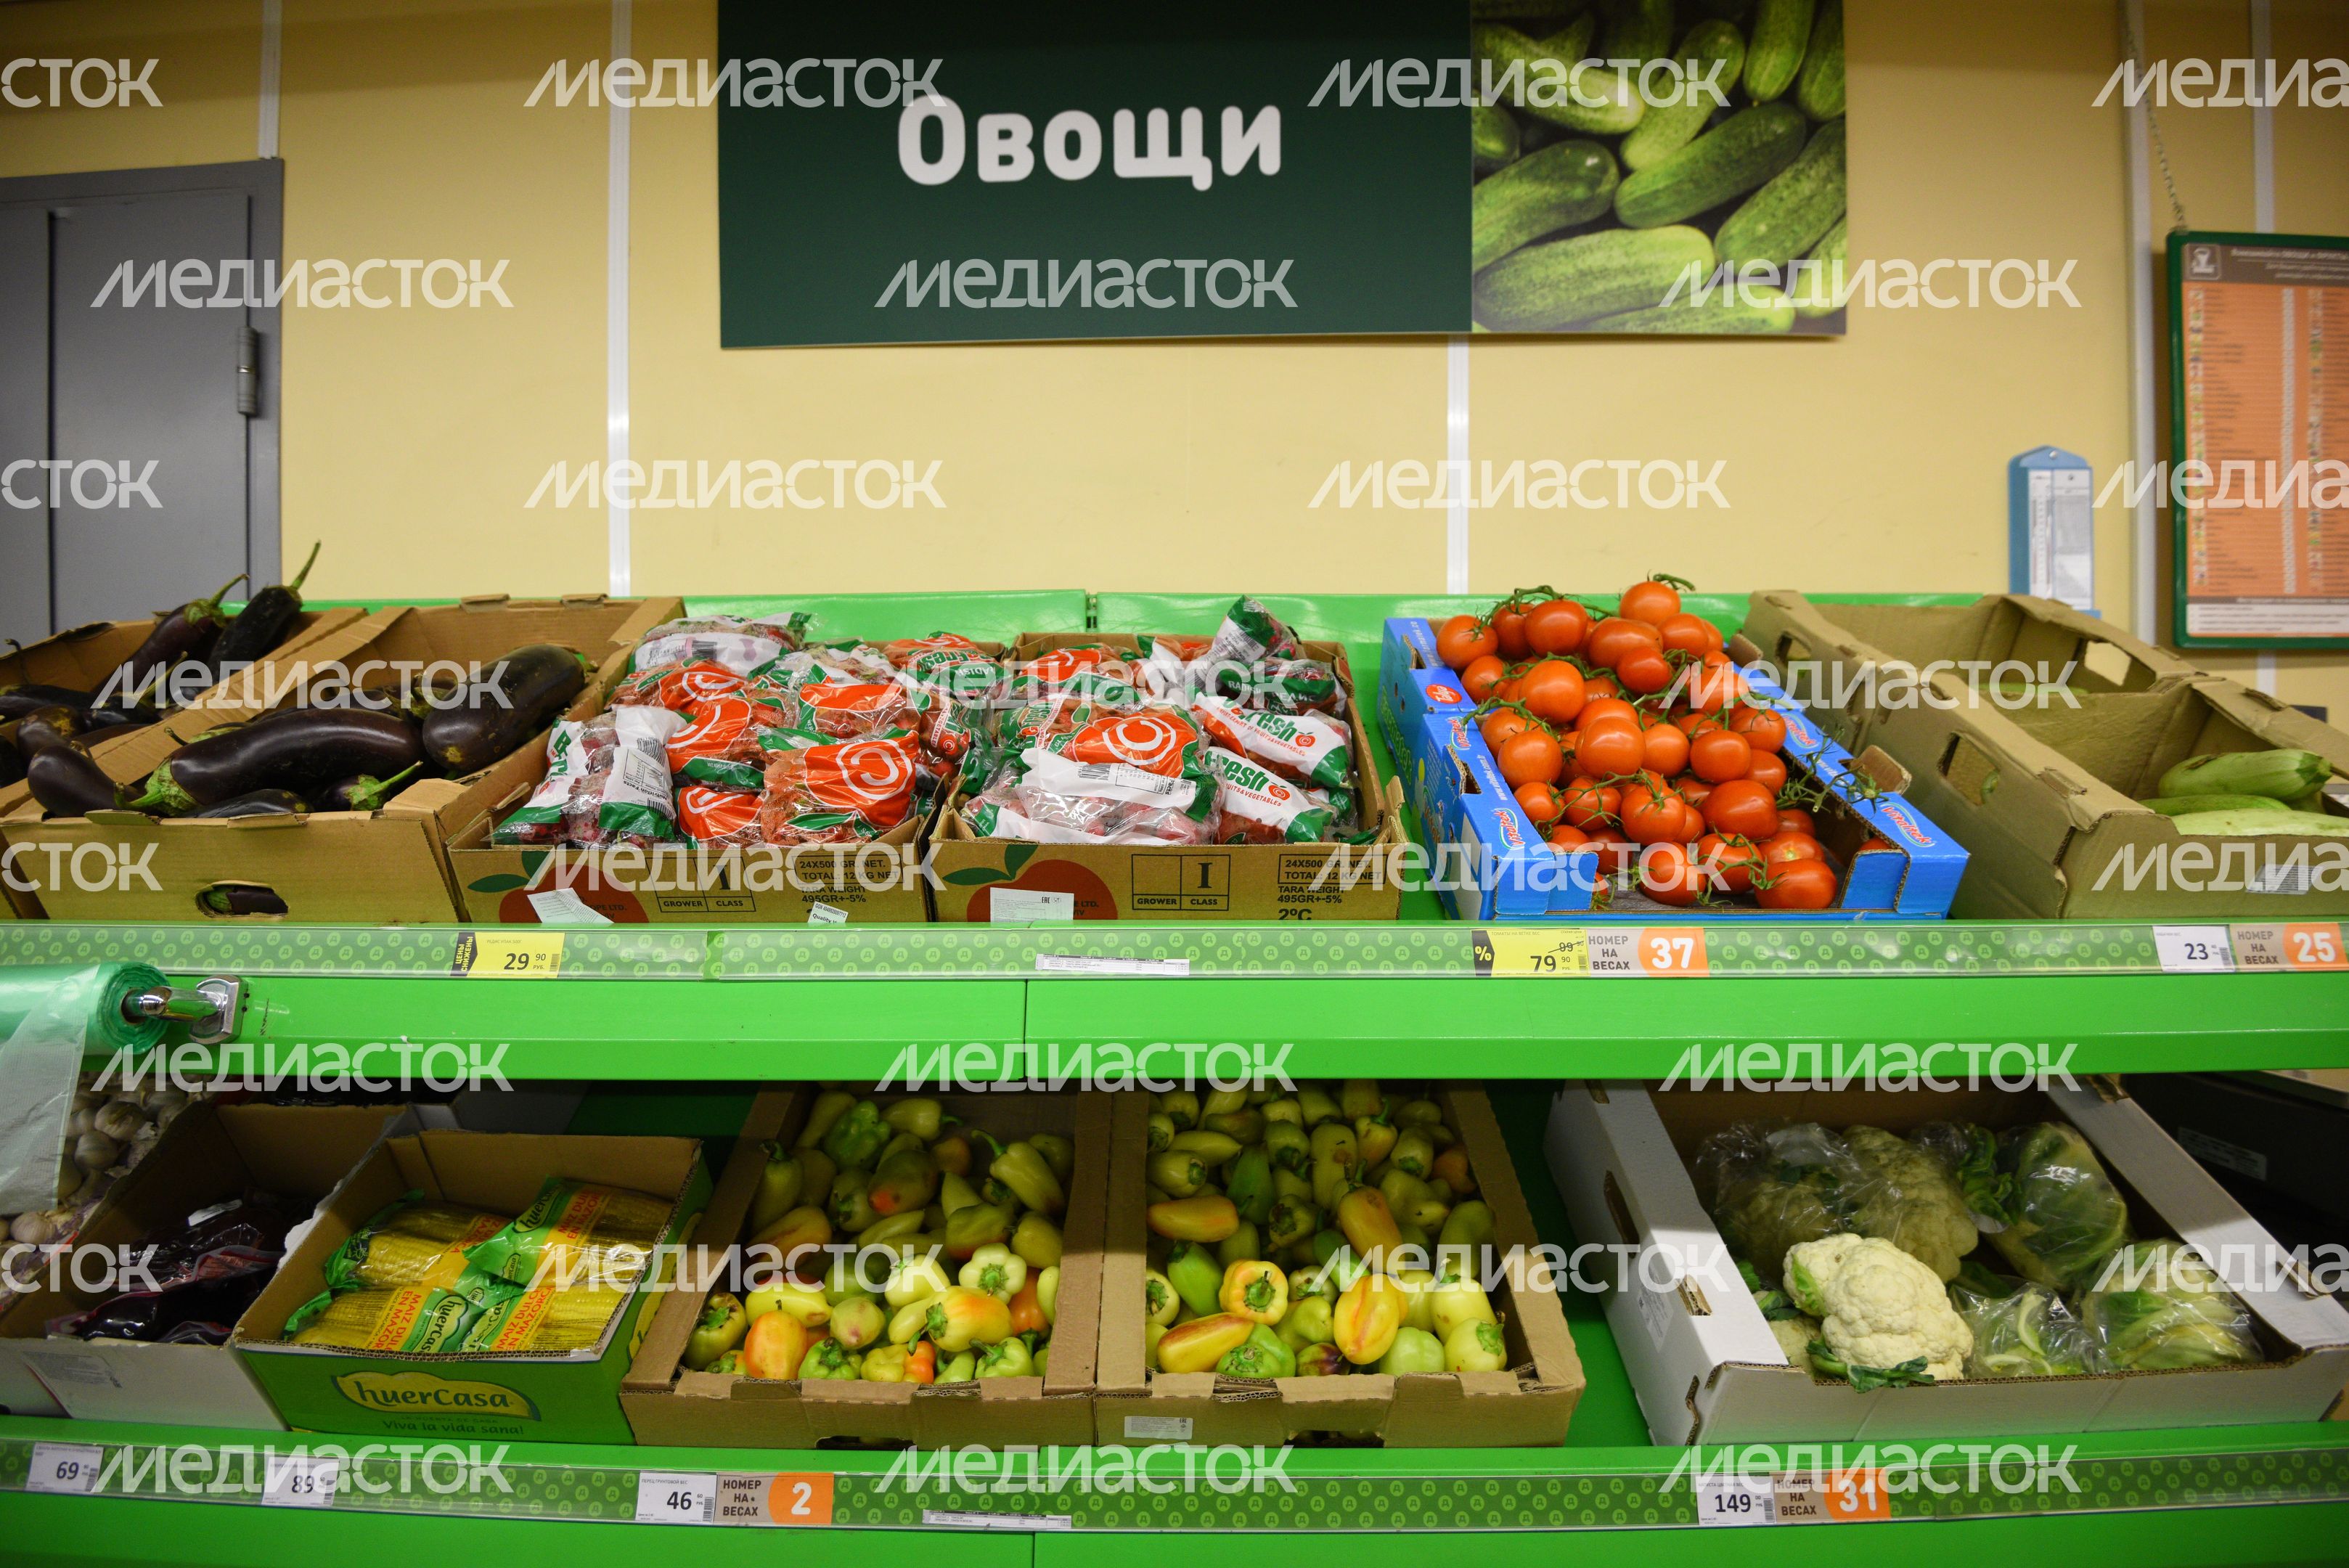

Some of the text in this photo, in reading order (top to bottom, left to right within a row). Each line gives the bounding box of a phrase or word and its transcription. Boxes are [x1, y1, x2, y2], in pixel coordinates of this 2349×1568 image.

[899, 95, 1281, 191] Овощи
[799, 860, 836, 869] 24X500
[1286, 859, 1323, 868] 24X500
[1285, 871, 1323, 880] TOTAL:
[1327, 871, 1338, 880] 12
[802, 894, 867, 903] 495GR+-5%
[1278, 895, 1342, 904] 495GR+-5%
[1588, 936, 1628, 944] НОМЕР
[2237, 931, 2274, 940] НОМЕР
[455, 944, 465, 964] ЦЕНЫ
[461, 936, 474, 972] СНИЖЕНЫ
[1559, 942, 1573, 952] 99
[1602, 949, 1618, 957] НА
[1651, 937, 1694, 968] 37
[2185, 943, 2209, 960] 23
[2293, 932, 2335, 963] 25
[504, 953, 529, 970] 29
[1530, 955, 1556, 973] 79
[1593, 961, 1630, 970] ВЕСАХ
[2244, 955, 2279, 965] ВЕСАХ
[399, 1290, 414, 1306] EN
[400, 1293, 422, 1325] MAIZ
[422, 1300, 462, 1352] huerCas
[495, 1319, 519, 1350] MAIZ
[354, 1381, 510, 1408] huerCasa
[383, 1419, 524, 1435] Viva la vida sana!
[57, 1461, 79, 1479] 69
[292, 1475, 315, 1493] 89
[723, 1479, 761, 1490] НОМЕР
[1778, 1479, 1814, 1489] НОМЕР
[666, 1491, 692, 1510] 46
[734, 1493, 748, 1503] НА
[791, 1482, 812, 1515] 2
[1715, 1494, 1751, 1512] 149
[1790, 1493, 1805, 1502] НА
[1839, 1479, 1876, 1512] 31
[722, 1506, 758, 1516] ВЕСАХ
[1781, 1506, 1816, 1516] ВЕСАХ
